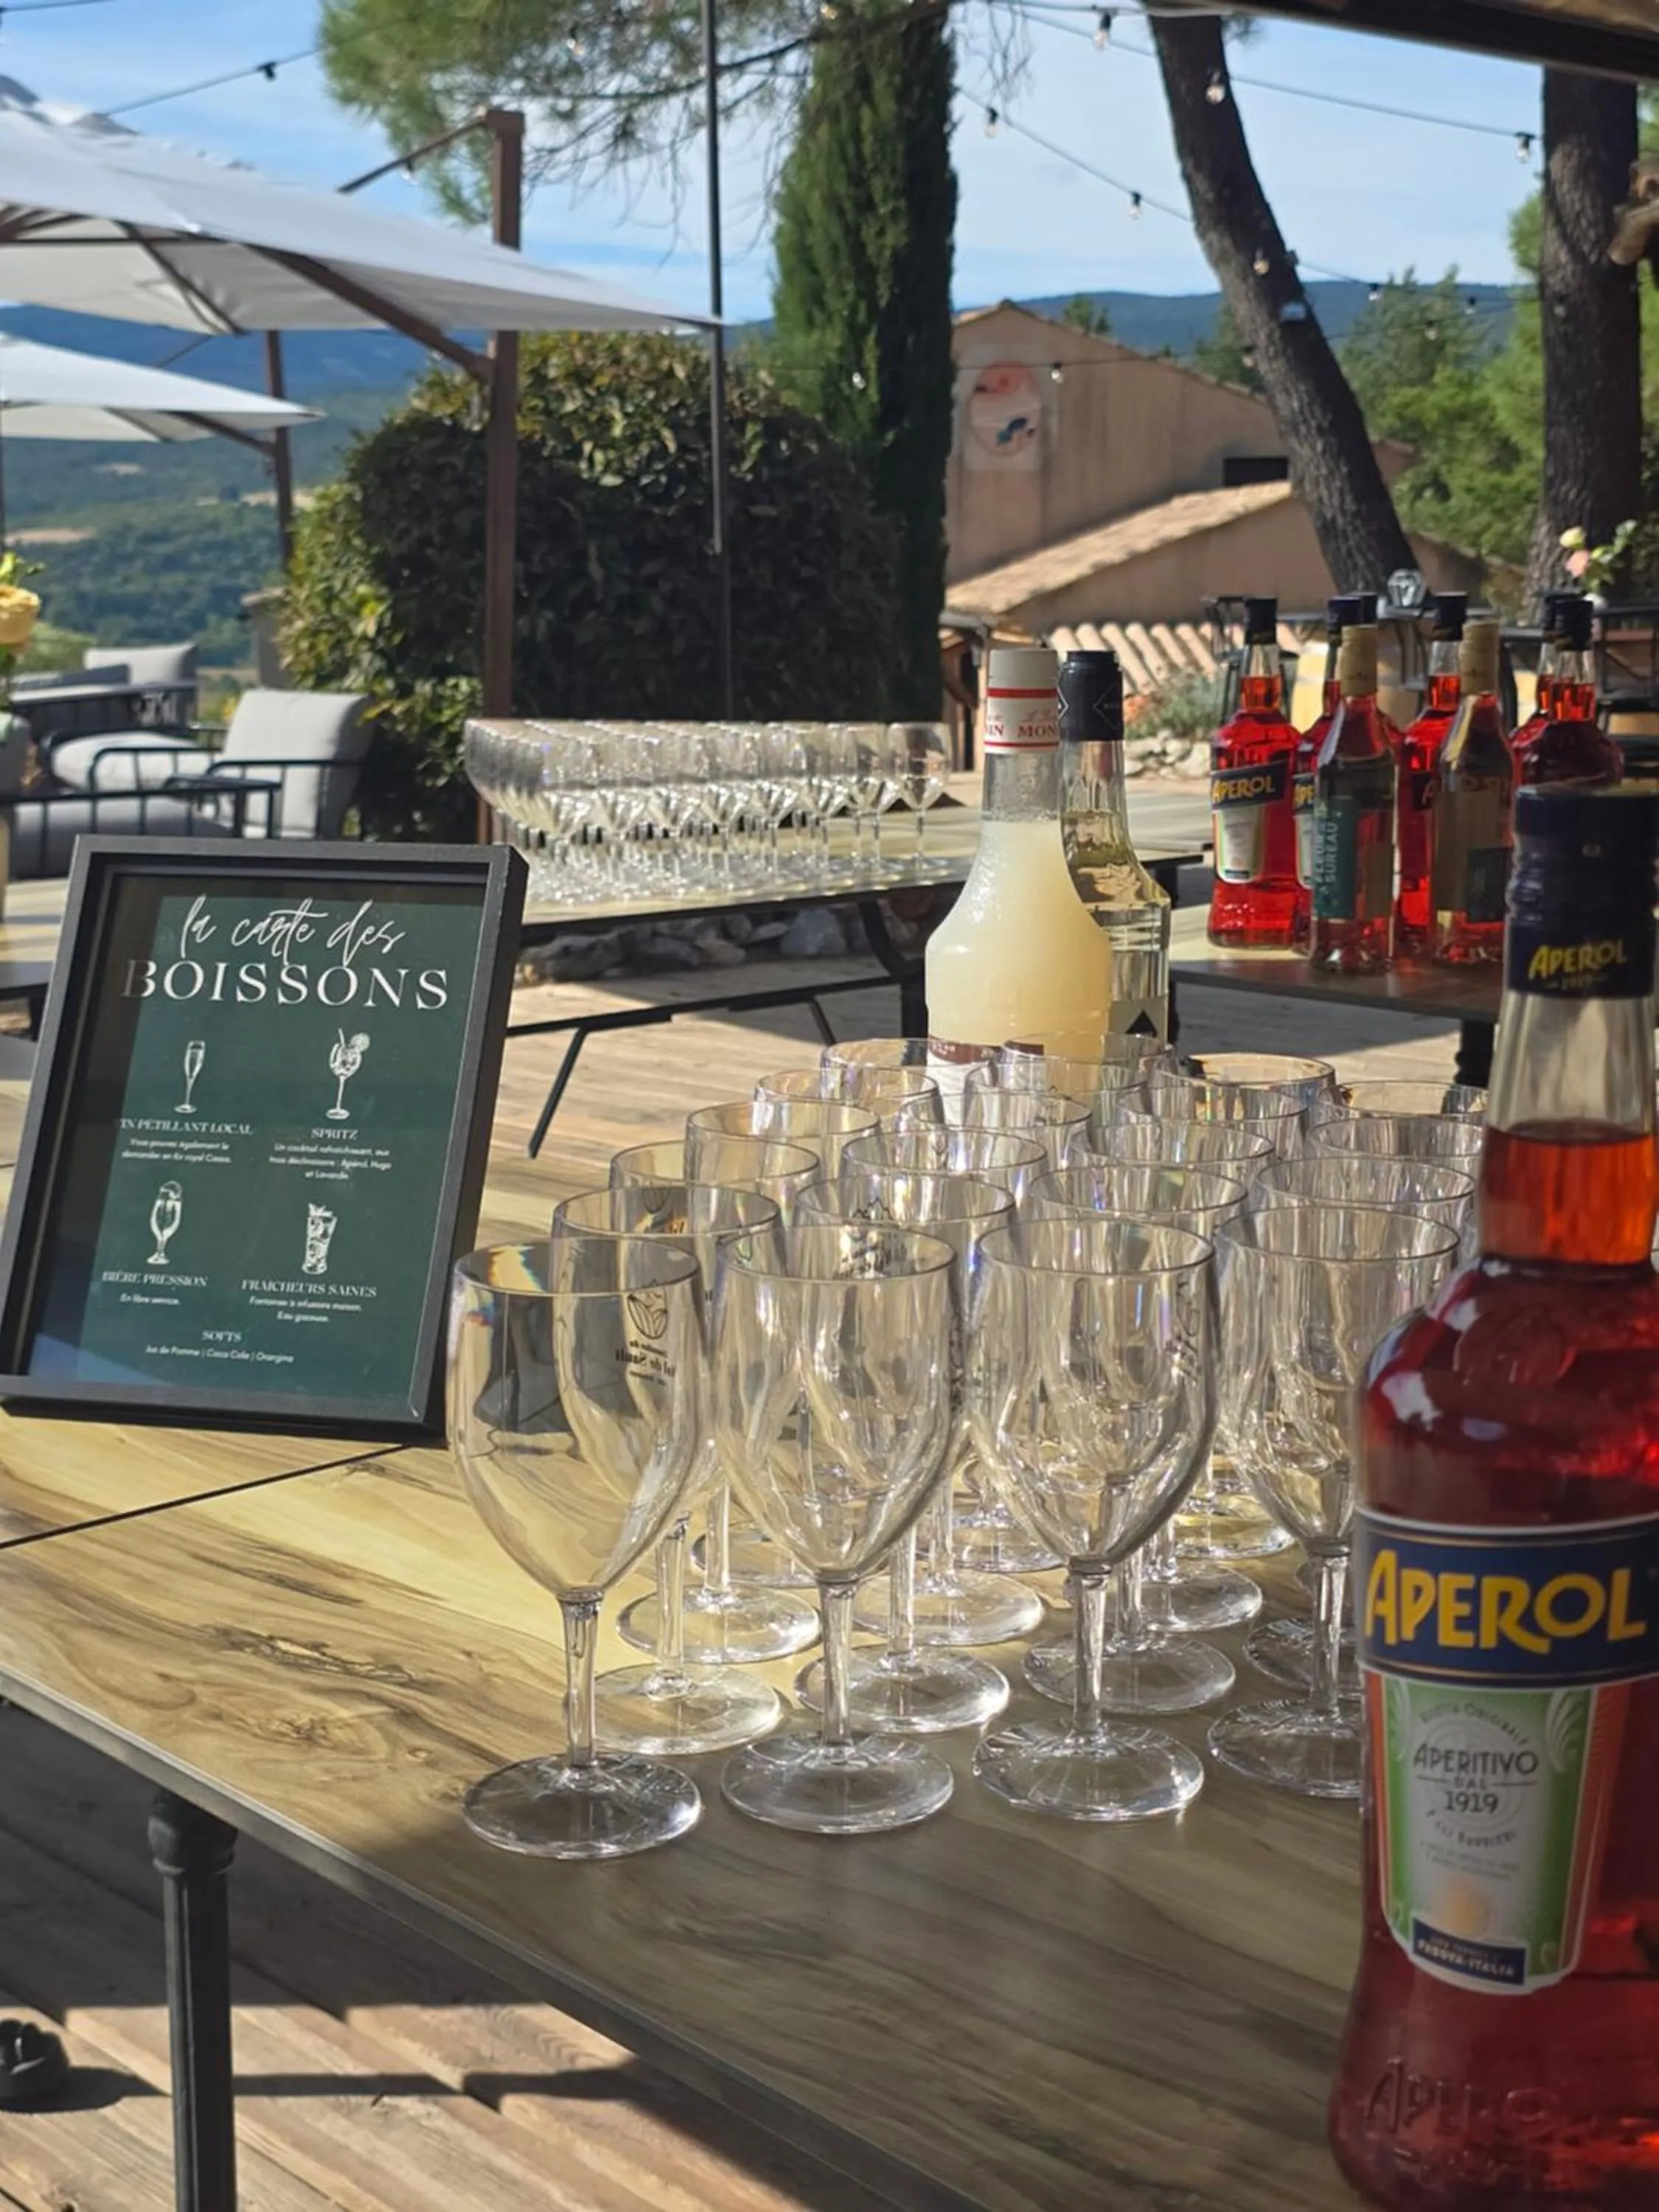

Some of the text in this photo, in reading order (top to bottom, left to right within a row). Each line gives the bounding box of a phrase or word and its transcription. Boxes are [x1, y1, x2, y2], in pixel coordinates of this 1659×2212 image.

[1212, 776, 1275, 804] APEROL
[1294, 784, 1315, 808] APE
[181, 894, 406, 968] la carte des
[1527, 939, 1627, 981] APEROL
[121, 959, 449, 1010] BOISSONS
[210, 1121, 254, 1135] LOCAL
[310, 1127, 359, 1141] SPRITZ
[142, 1273, 209, 1287] PRESSION
[201, 1330, 243, 1342] SOFTS
[1364, 1549, 1647, 1655] APEROL
[1413, 1742, 1540, 1775] APERITIVO
[1453, 1775, 1487, 1791] DAL
[1444, 1790, 1500, 1814] 1919
